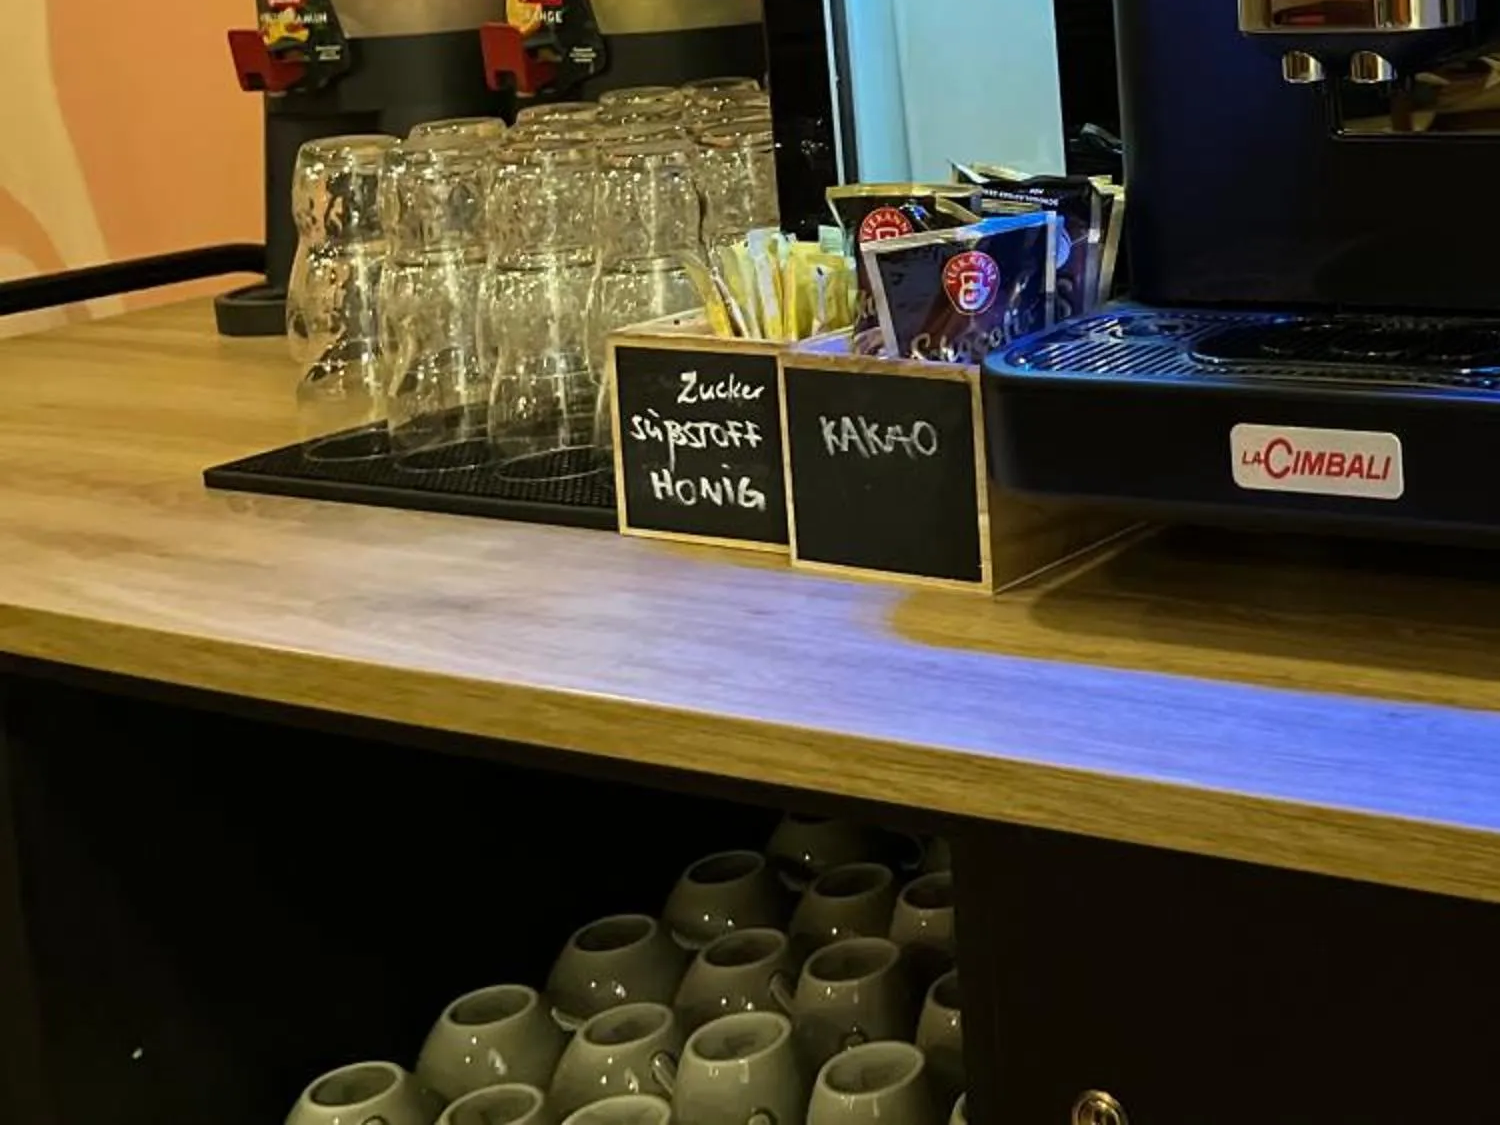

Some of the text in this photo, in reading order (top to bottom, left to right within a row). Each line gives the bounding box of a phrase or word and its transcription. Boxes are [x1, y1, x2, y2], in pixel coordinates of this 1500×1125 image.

[677, 370, 765, 405] Zucker
[819, 415, 939, 459] KAKAO
[1242, 437, 1392, 481] LA CIMBALI
